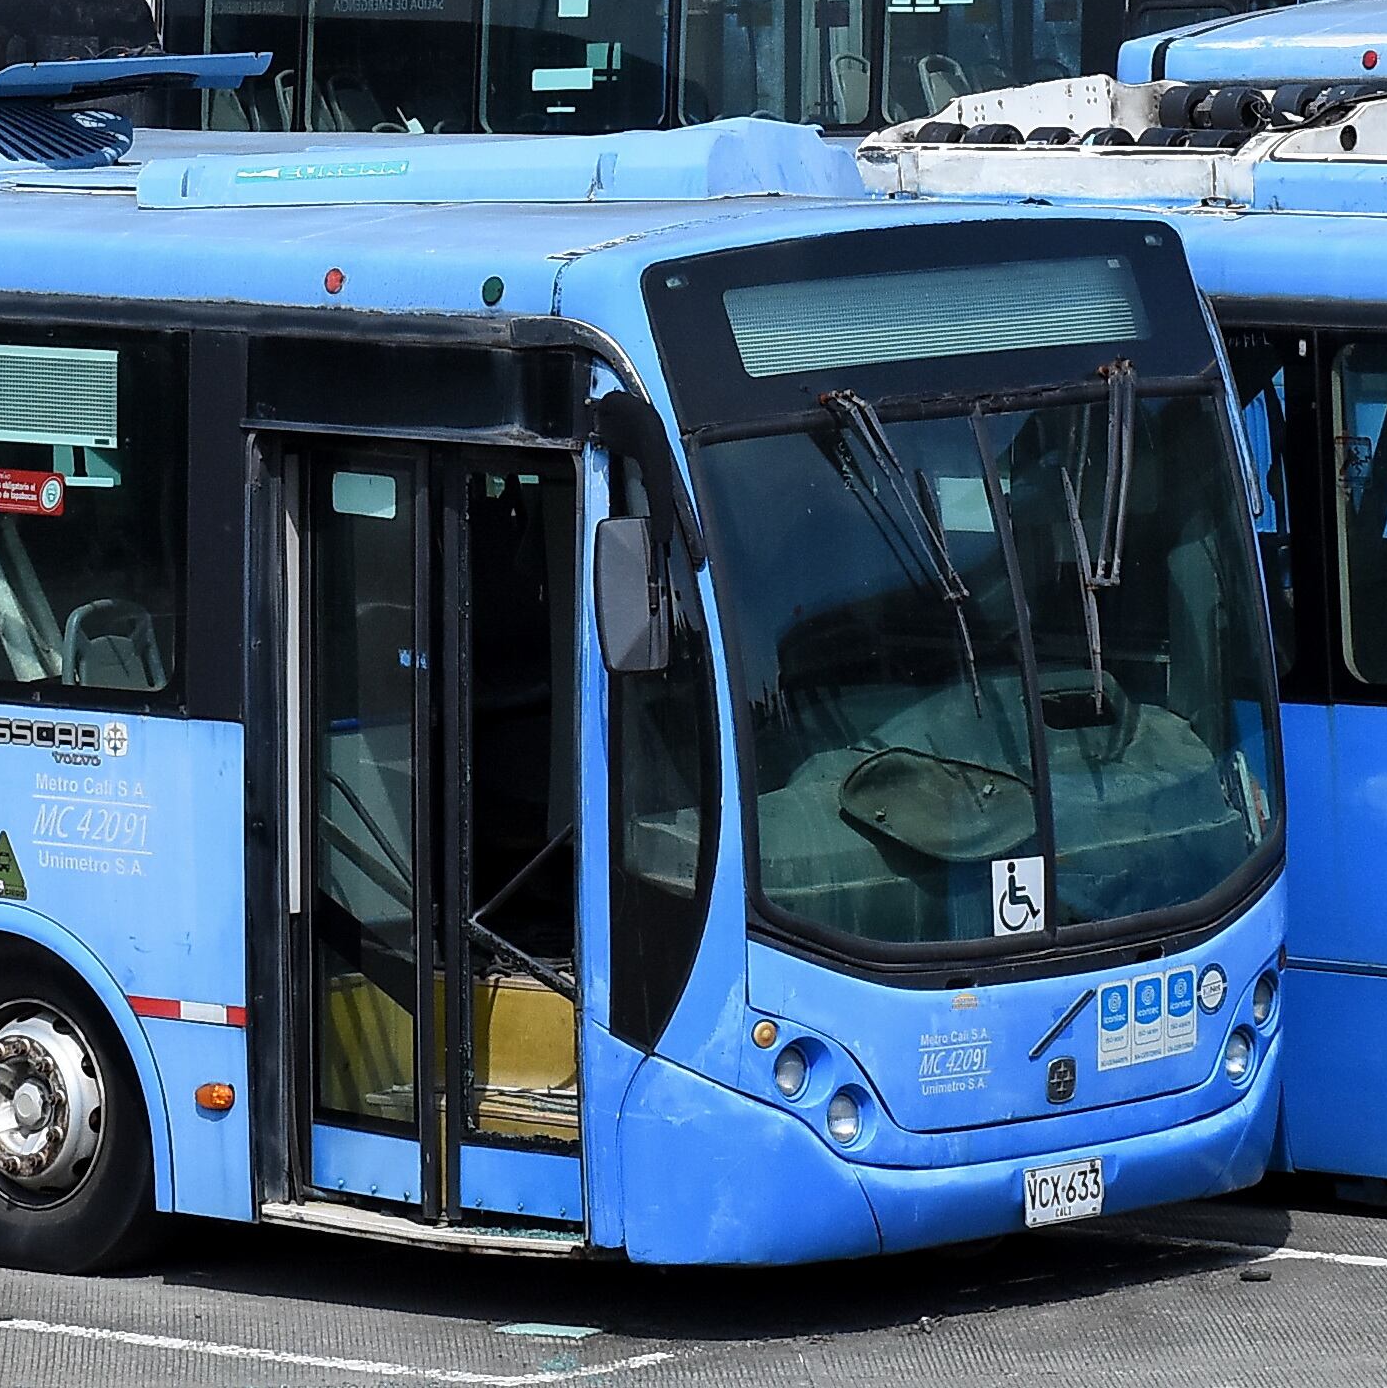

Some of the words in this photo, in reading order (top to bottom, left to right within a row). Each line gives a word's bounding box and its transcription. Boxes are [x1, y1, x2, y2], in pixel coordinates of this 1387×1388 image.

[52, 750, 102, 766] VOLVO
[36, 772, 78, 792] Metro
[84, 777, 112, 796] Cali
[33, 803, 74, 838] MC
[38, 849, 110, 874] Unimetro
[115, 859, 148, 877] S.A.
[920, 1033, 948, 1046] Metro
[950, 1030, 969, 1043] Cali
[922, 1082, 966, 1096] Unimetro
[1055, 1205, 1072, 1217] CALI
